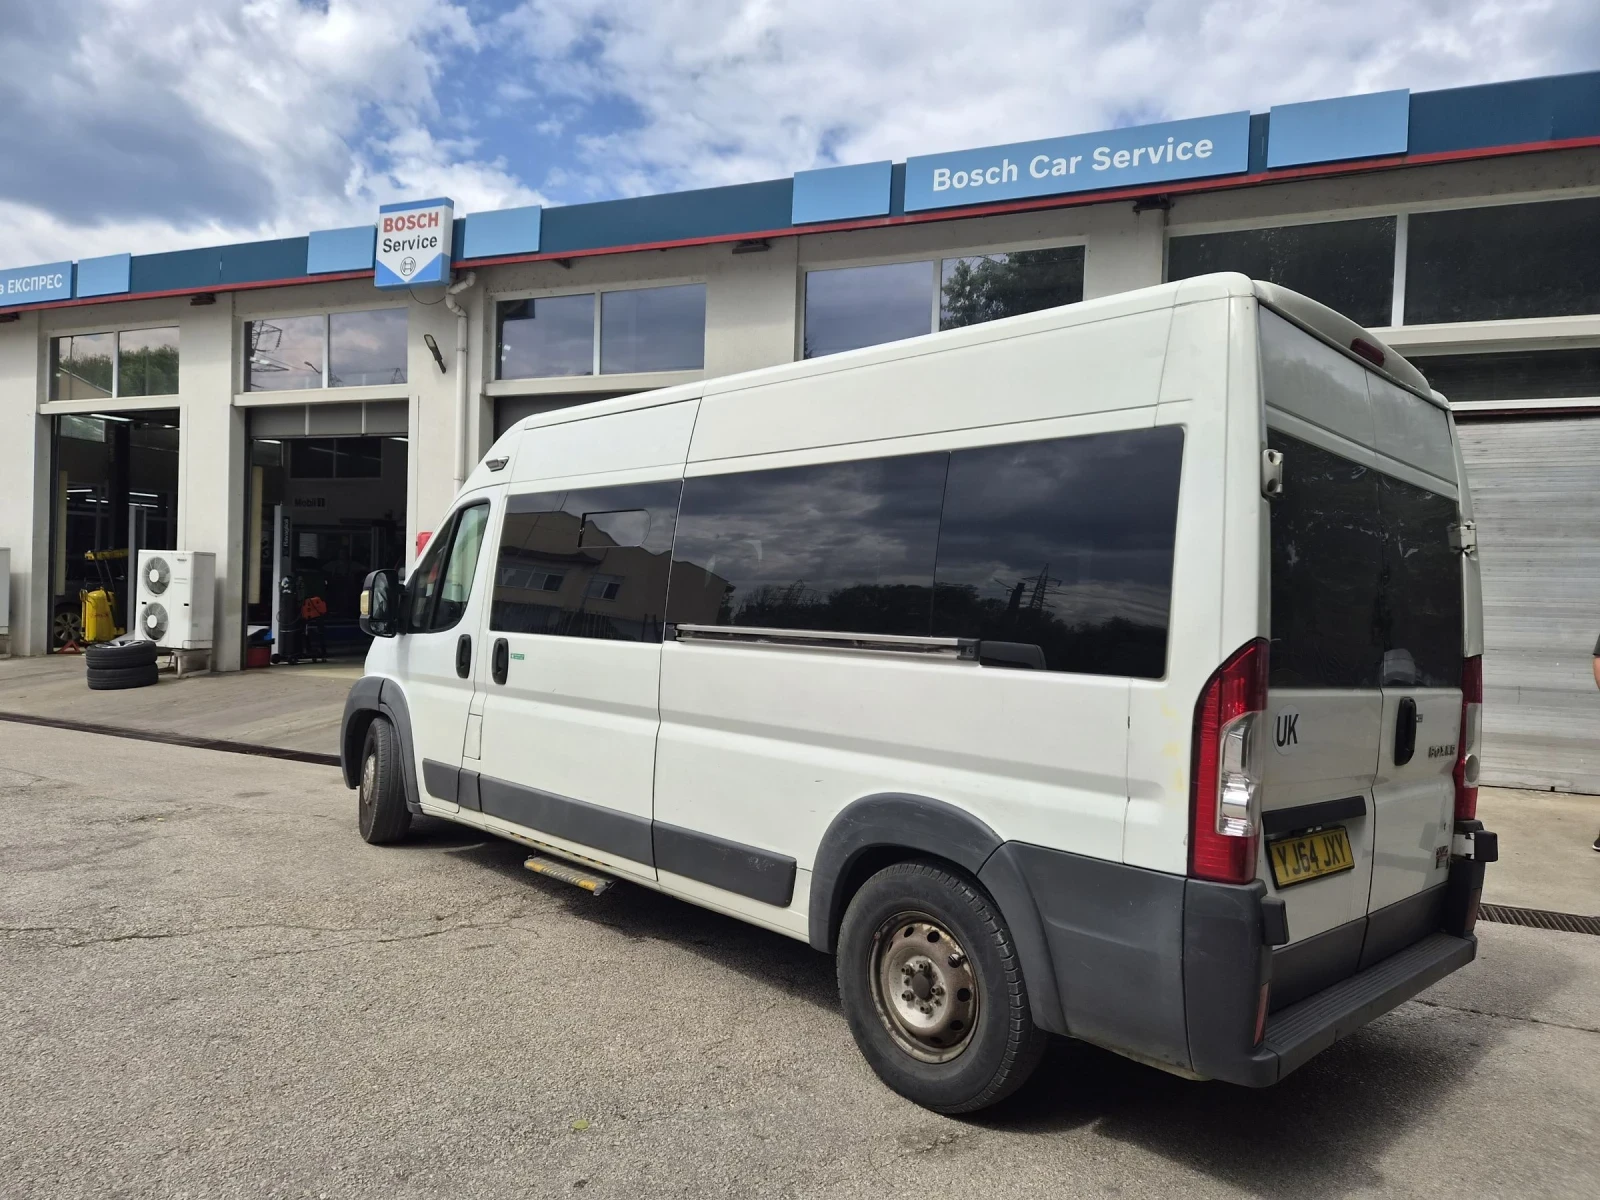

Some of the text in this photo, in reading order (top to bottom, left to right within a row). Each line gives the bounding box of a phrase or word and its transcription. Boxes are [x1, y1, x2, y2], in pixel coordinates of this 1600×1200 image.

[932, 136, 1213, 192] Bosch Car Service
[383, 211, 439, 233] BOSCH
[382, 234, 438, 253] Service
[7, 273, 63, 294] ЕКСПРЕС
[1277, 714, 1299, 747] UK
[1277, 833, 1346, 877] YJ64 JXY
